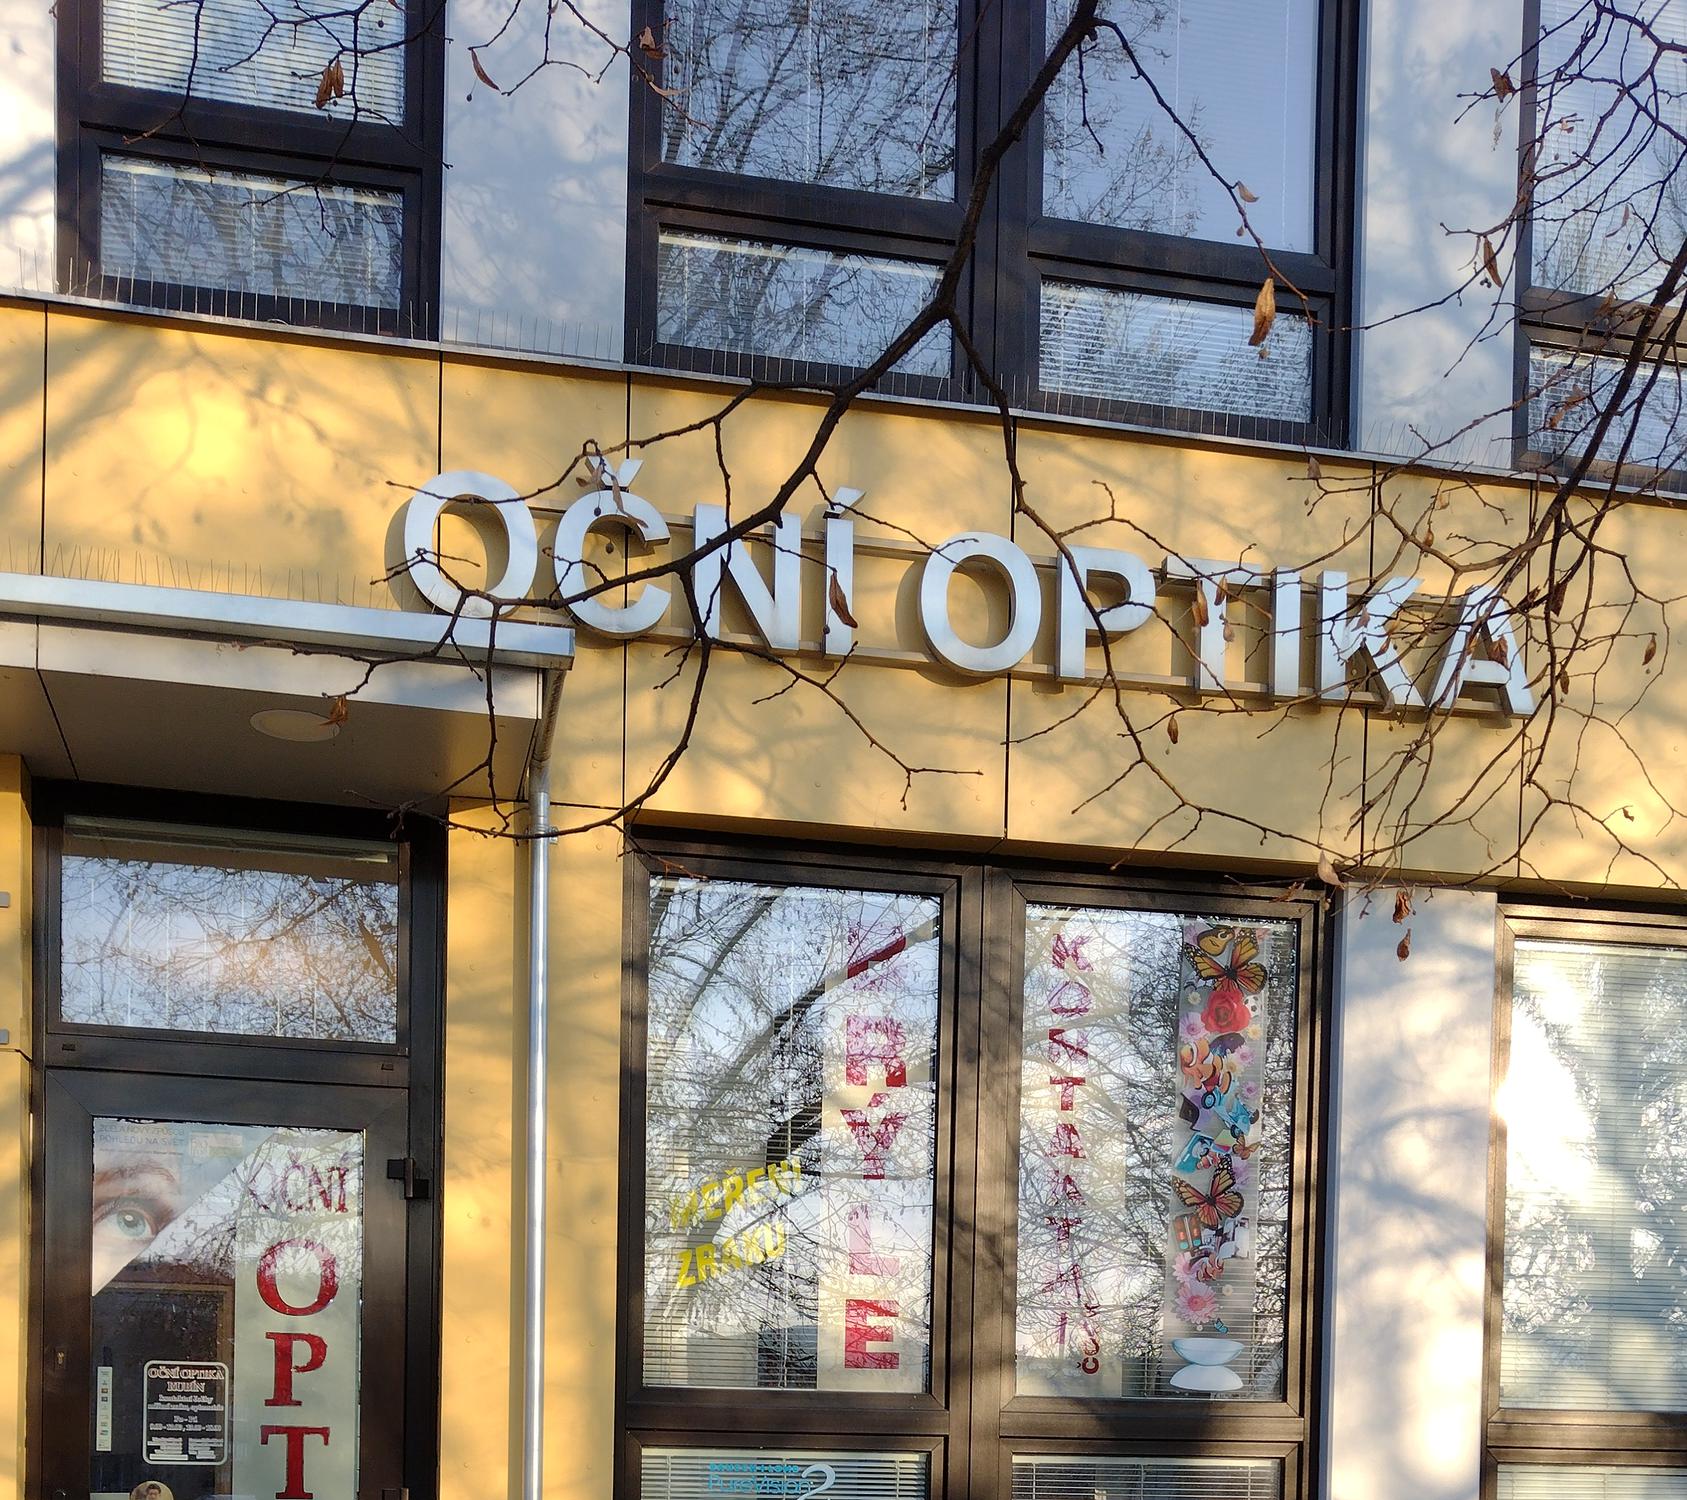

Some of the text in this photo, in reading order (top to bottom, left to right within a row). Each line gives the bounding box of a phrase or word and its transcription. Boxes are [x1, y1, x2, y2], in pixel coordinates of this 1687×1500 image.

[404, 456, 1535, 716] OČNÍ OPTIKA
[677, 1222, 786, 1289] ZRAKU
[148, 1364, 180, 1379] OČNÍ
